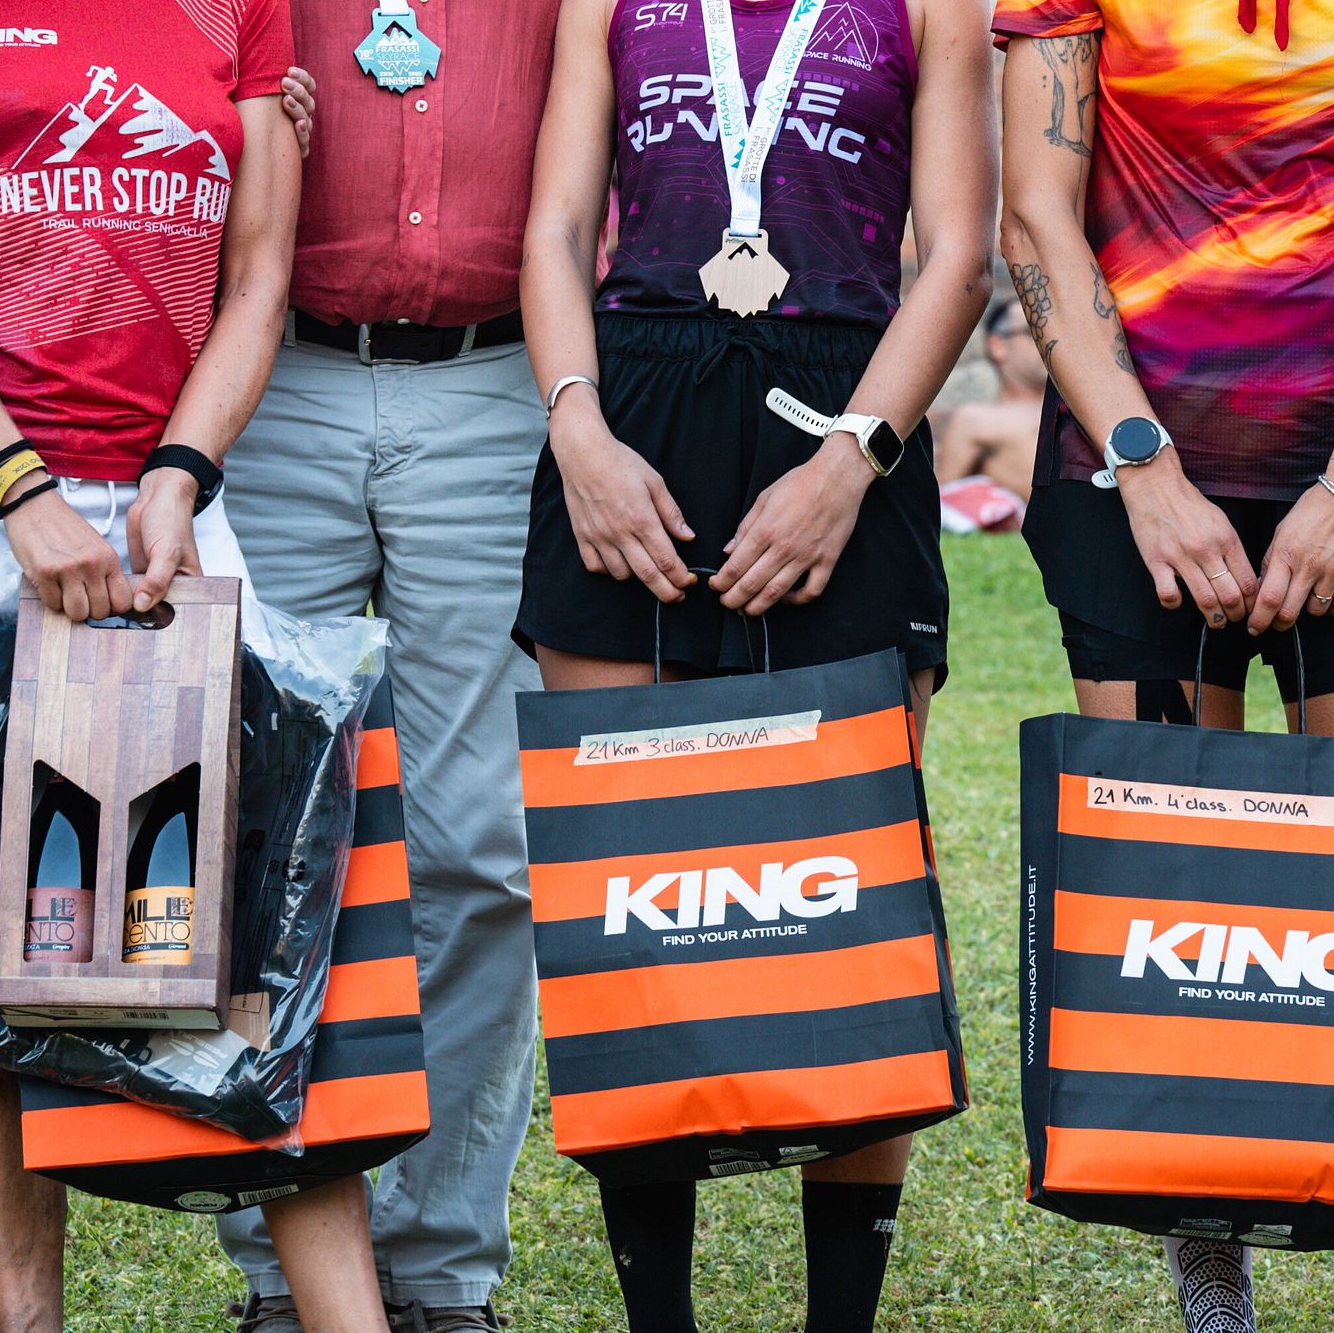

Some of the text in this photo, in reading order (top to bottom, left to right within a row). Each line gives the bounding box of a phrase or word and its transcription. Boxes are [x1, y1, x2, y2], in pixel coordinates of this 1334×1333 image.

[634, 3, 688, 32] S74
[376, 52, 420, 60] SKYRACE
[783, 28, 808, 75] FRASASSI
[832, 54, 872, 71] RUNNING
[379, 77, 423, 86] FINISHER
[717, 82, 733, 137] FRASASSI
[751, 137, 768, 172] GROTTE
[0, 166, 104, 215] NEVER
[112, 167, 187, 216] STOP
[41, 218, 208, 239] TRAIL RUNNING SENIGALLIA
[586, 726, 768, 760] 21 Km 3 class. DONNA
[1093, 786, 1115, 805] 21
[1185, 797, 1233, 812] class.
[1243, 798, 1309, 818] DONNA
[604, 855, 859, 936] KING
[24, 922, 75, 943] NTO
[662, 924, 808, 946] FIND YOUR ATTITUDE
[1027, 865, 1037, 1066] WWW.KINGATTITUDE.IT
[1178, 987, 1326, 1007] FIND YOUR ATTITUDE
